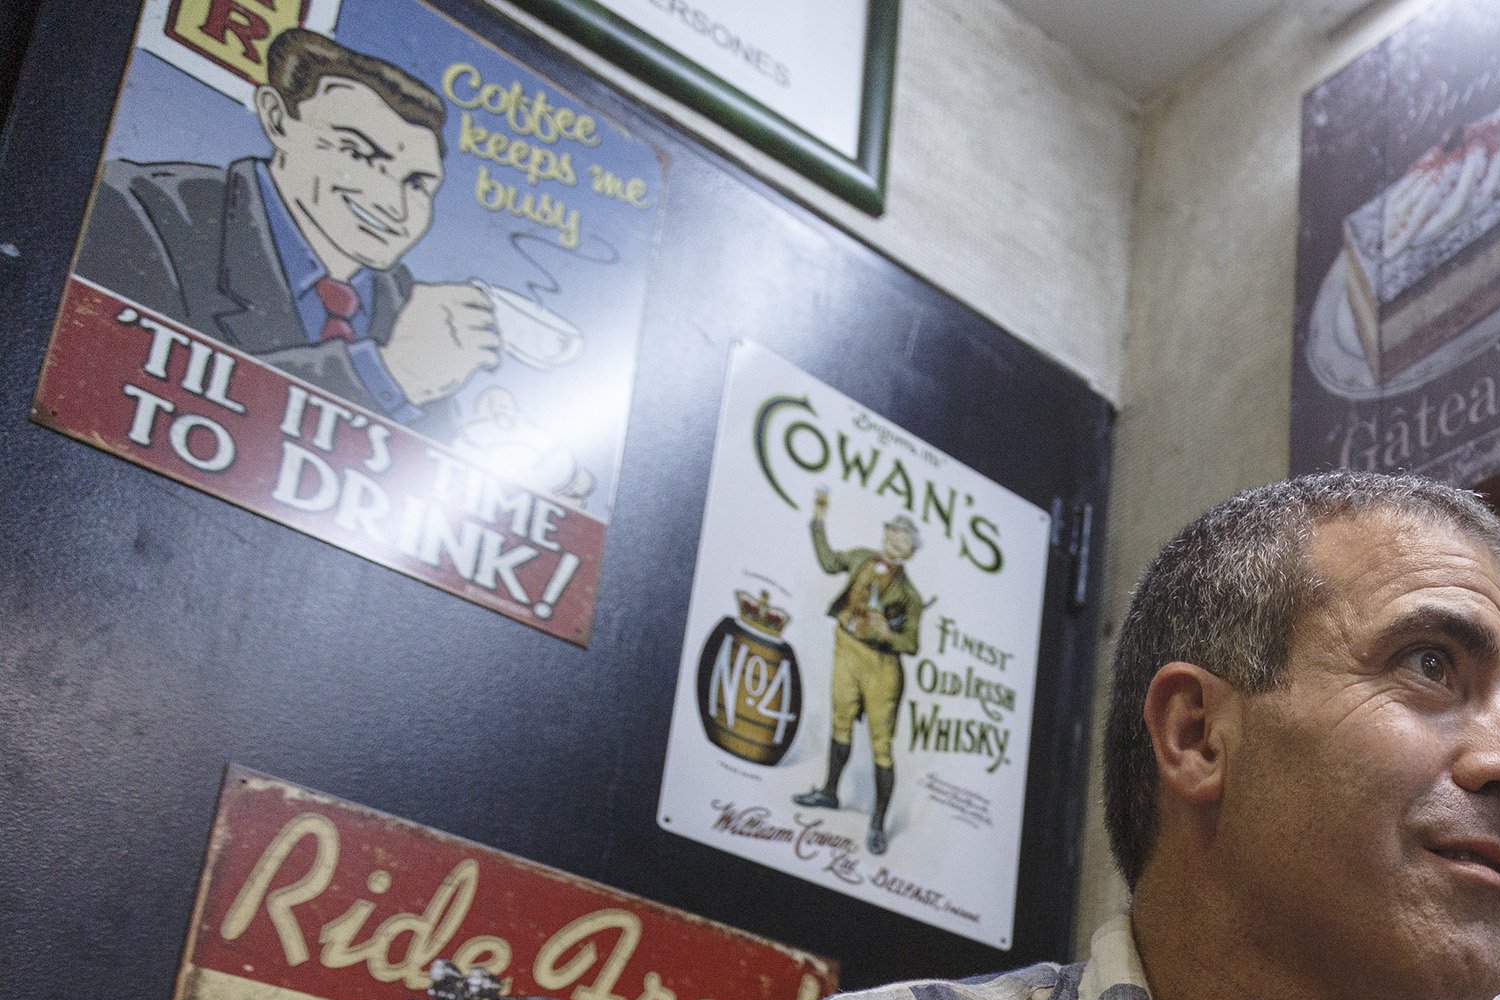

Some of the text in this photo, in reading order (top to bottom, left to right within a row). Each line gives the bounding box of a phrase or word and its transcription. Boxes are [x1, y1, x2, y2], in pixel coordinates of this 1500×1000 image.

[441, 62, 601, 147] Coffee
[459, 111, 651, 209] keeps me
[476, 165, 581, 250] busy
[116, 308, 567, 552] 'TIL IT'S TIME
[123, 384, 581, 620] TO DRINK!
[219, 814, 513, 990] Ride
